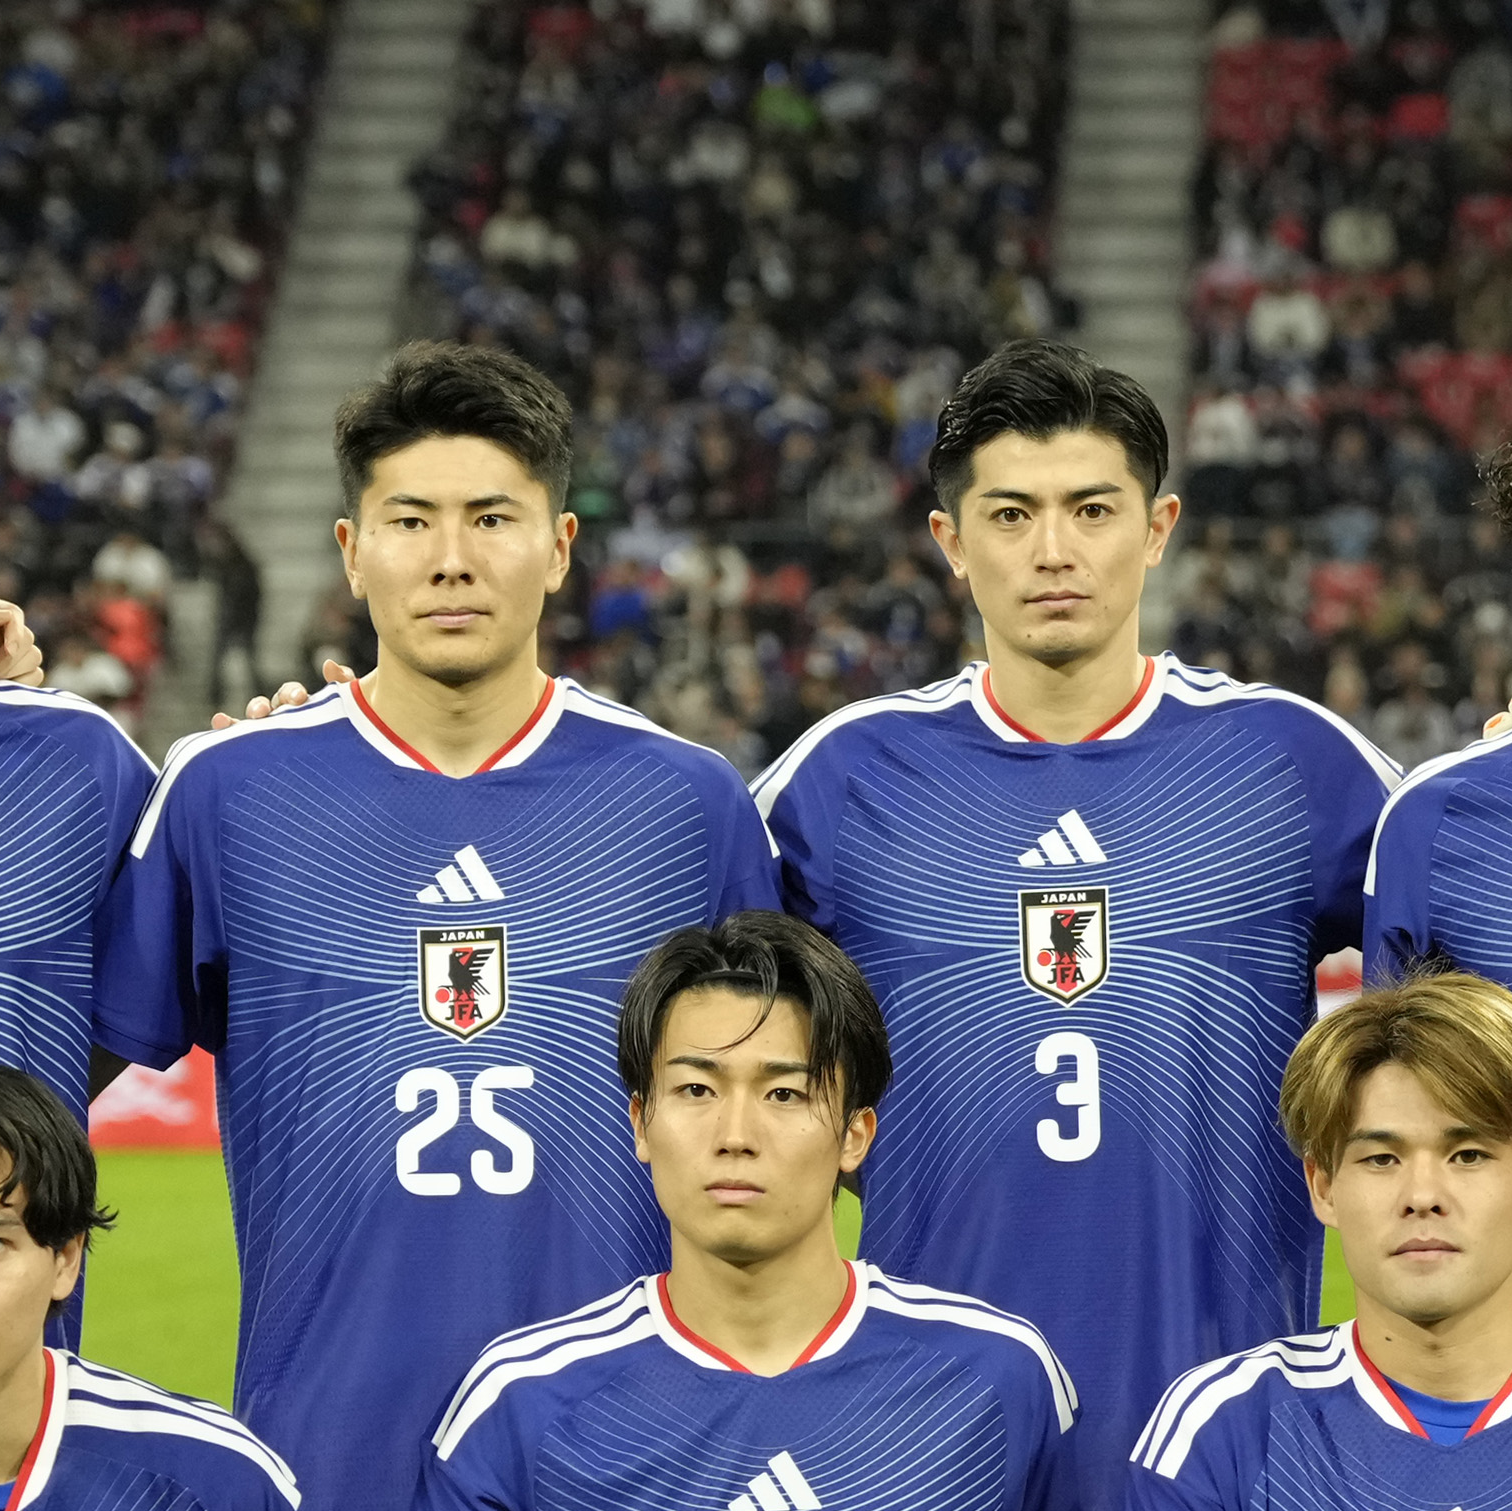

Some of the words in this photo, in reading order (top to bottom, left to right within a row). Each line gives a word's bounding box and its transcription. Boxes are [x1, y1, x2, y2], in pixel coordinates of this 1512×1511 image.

[1040, 892, 1087, 904] JAPAN
[439, 930, 485, 942] JAPAN
[1047, 965, 1085, 984] JFA
[445, 1003, 483, 1021] JFA
[1035, 1032, 1101, 1162] 3
[395, 1066, 534, 1196] 25
